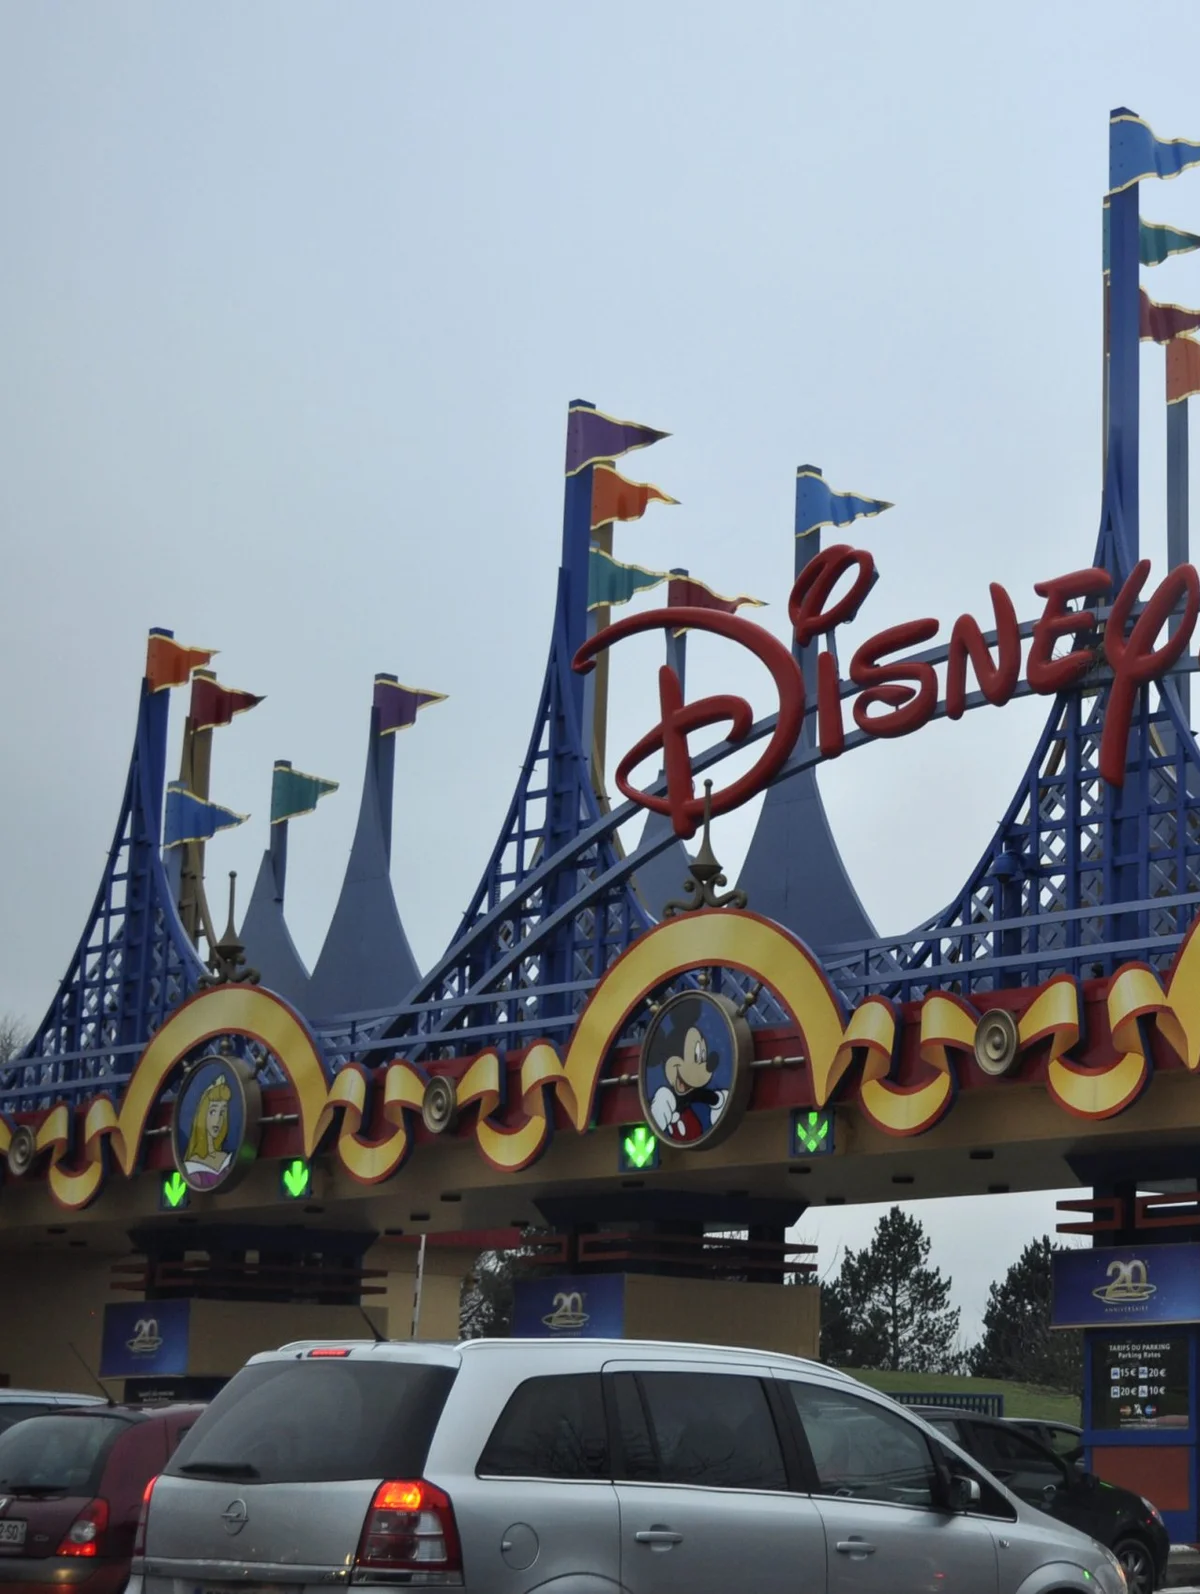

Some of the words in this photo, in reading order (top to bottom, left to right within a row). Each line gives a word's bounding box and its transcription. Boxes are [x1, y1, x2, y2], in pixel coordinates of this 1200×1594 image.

[1106, 1259, 1147, 1298] 20
[1109, 1344, 1130, 1352] TARIFS
[1142, 1343, 1171, 1351] PARKING
[1118, 1352, 1142, 1360] Parking
